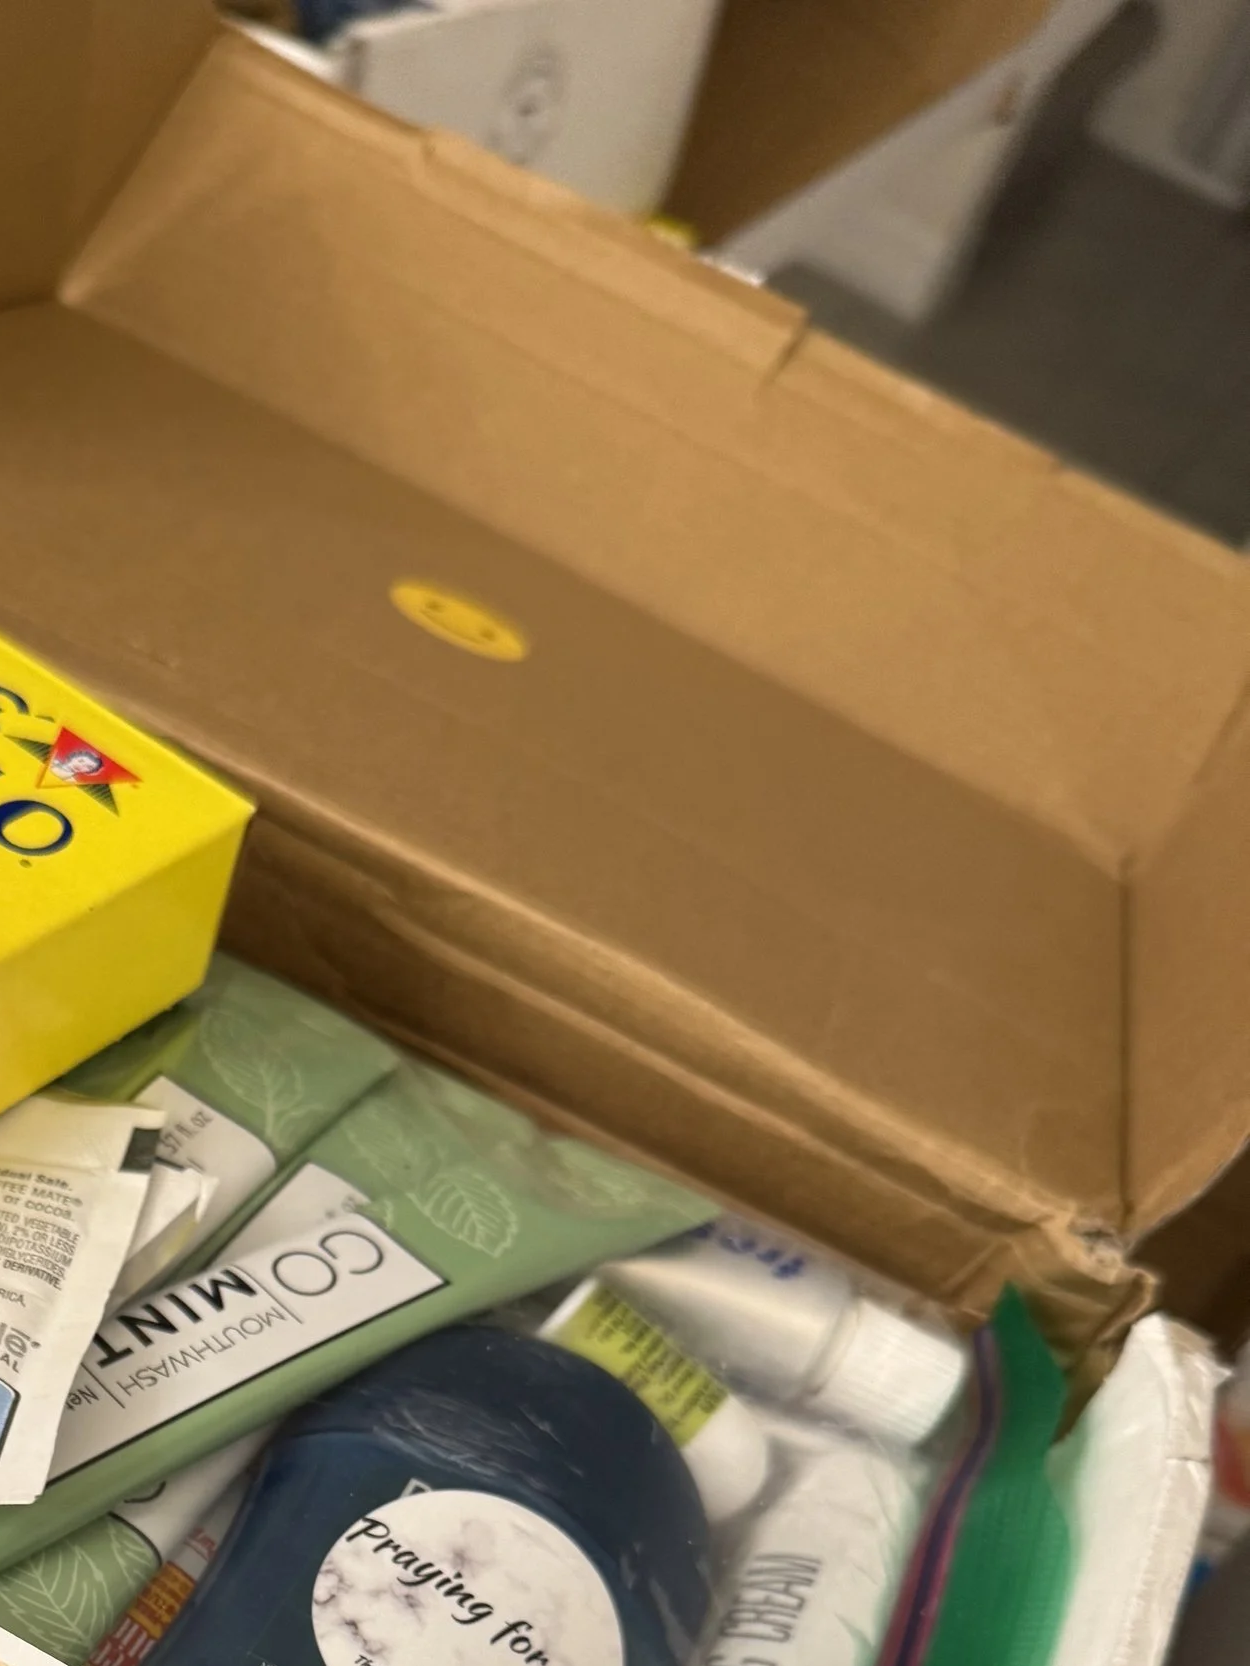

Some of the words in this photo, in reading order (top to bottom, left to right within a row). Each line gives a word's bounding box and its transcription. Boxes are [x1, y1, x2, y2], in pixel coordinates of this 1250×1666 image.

[271, 1229, 385, 1298] GO
[90, 1267, 258, 1369] MINT
[115, 1305, 286, 1398] MOUTHWASH
[345, 1516, 497, 1626] Praying
[724, 1551, 823, 1644] CREAM
